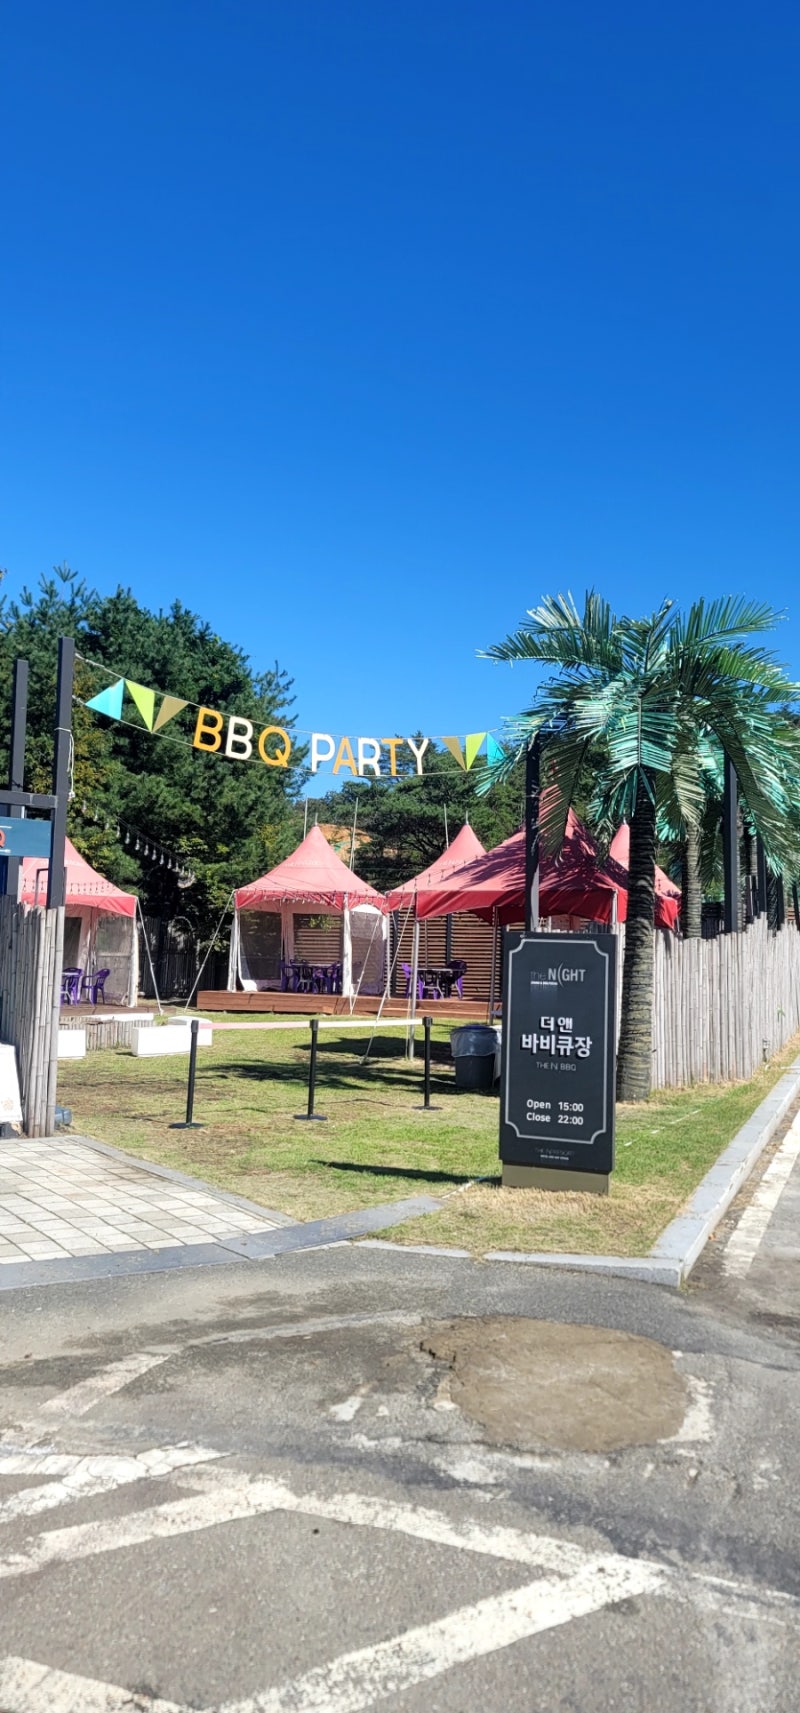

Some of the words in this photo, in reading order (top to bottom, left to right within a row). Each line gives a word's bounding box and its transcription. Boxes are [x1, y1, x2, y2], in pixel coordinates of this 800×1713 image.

[193, 706, 292, 768] BBQ
[311, 732, 429, 776] PARTY
[540, 1016, 555, 1031] 더
[557, 1016, 573, 1033] 앤
[521, 1033, 593, 1057] 바비큐장
[536, 1061, 550, 1070] THE
[560, 1062, 577, 1071] BBQ
[526, 1099, 551, 1110] Open
[558, 1102, 584, 1112] 15:00
[526, 1112, 551, 1123] Close
[557, 1115, 584, 1125] 22:00
